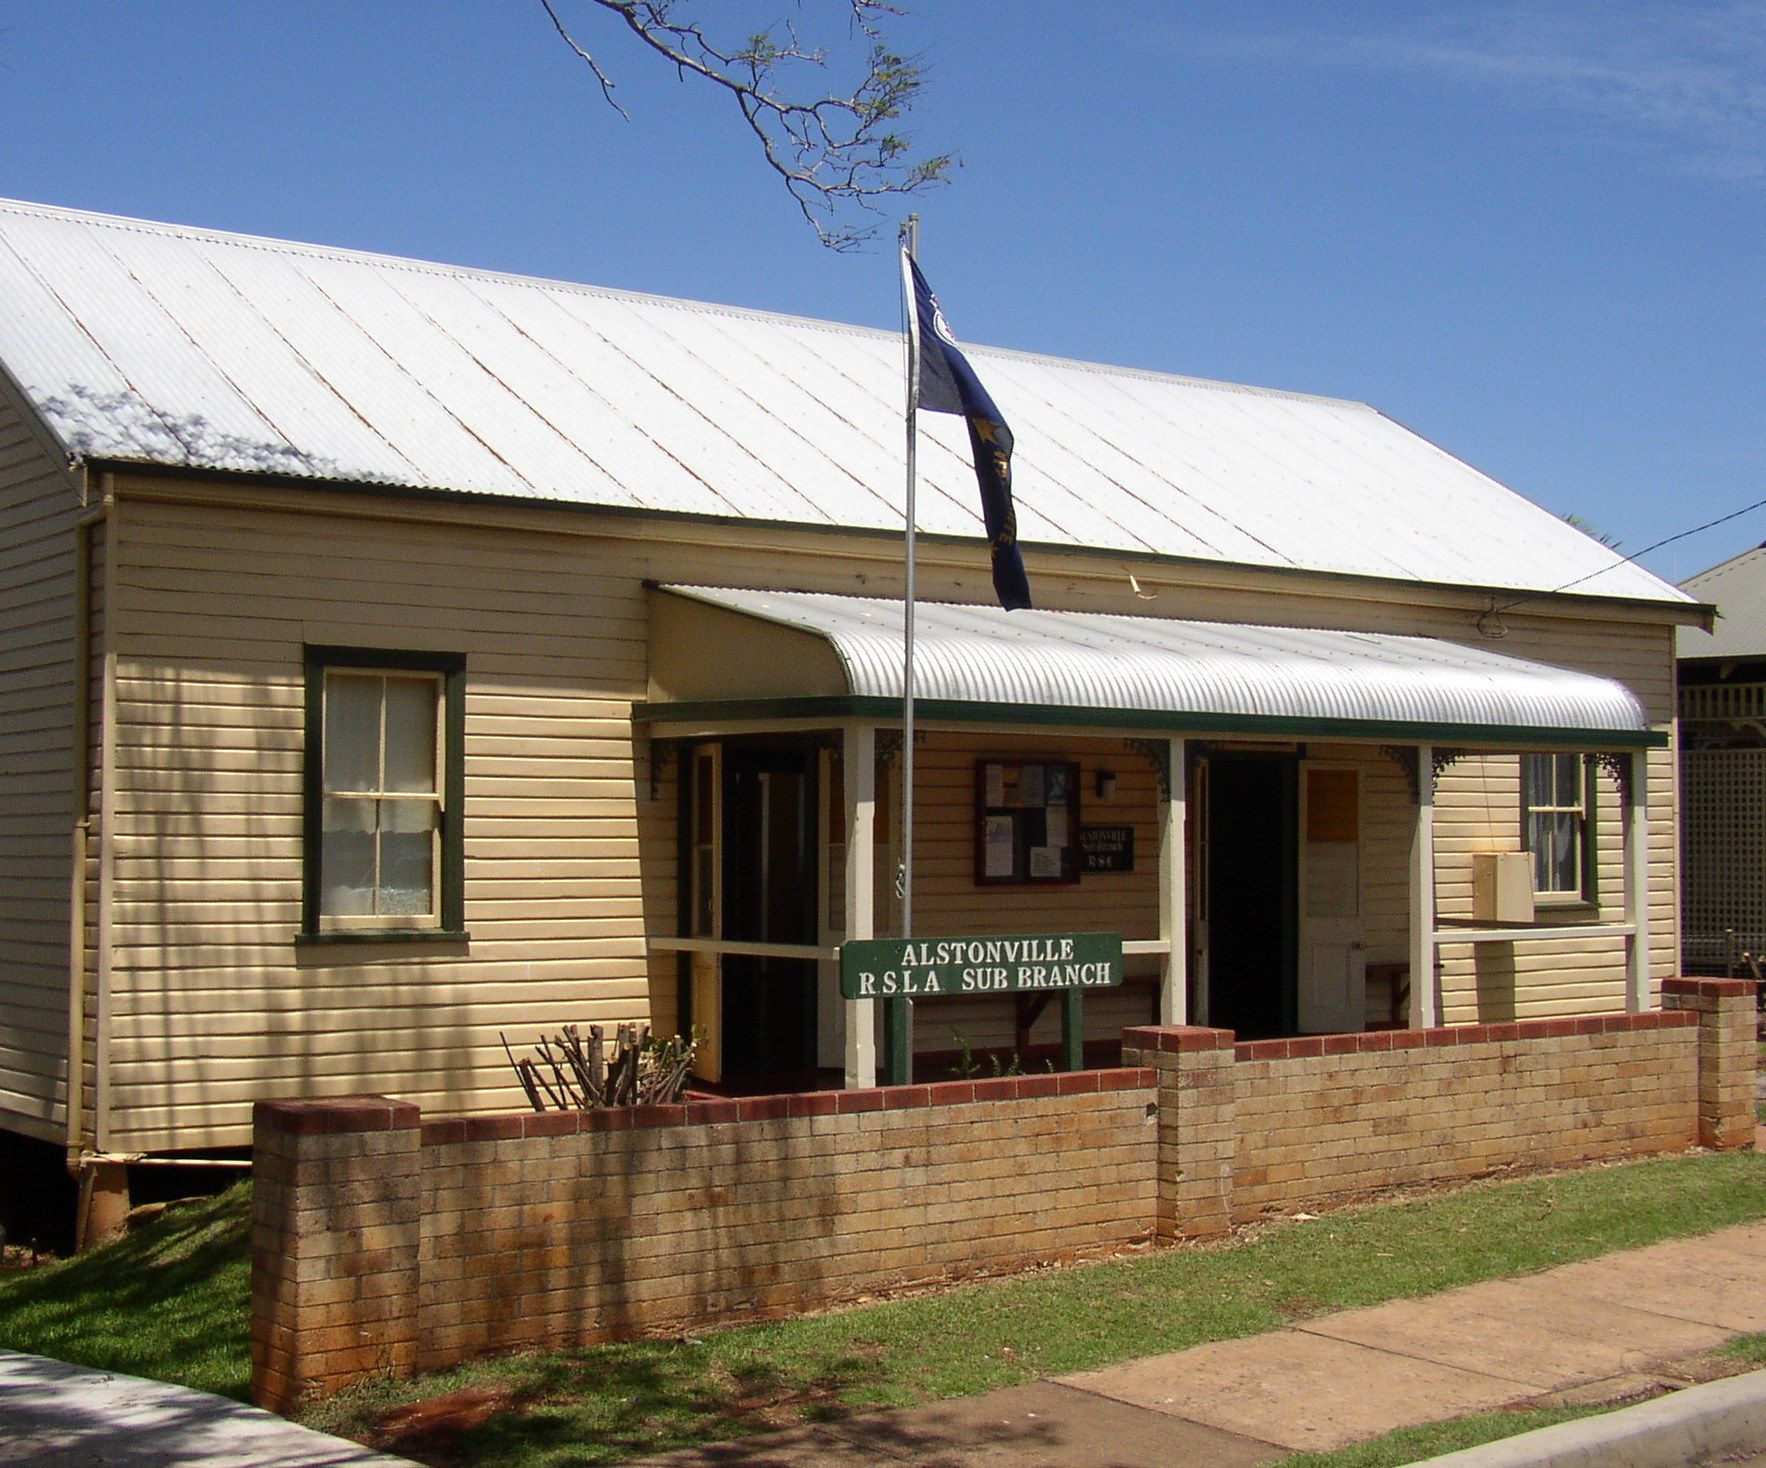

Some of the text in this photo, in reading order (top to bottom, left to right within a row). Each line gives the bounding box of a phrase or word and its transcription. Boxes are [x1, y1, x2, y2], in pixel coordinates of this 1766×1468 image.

[901, 938, 1075, 966] ALSTONVILLE
[962, 967, 1008, 991] SUB
[1017, 962, 1111, 989] BRANCH
